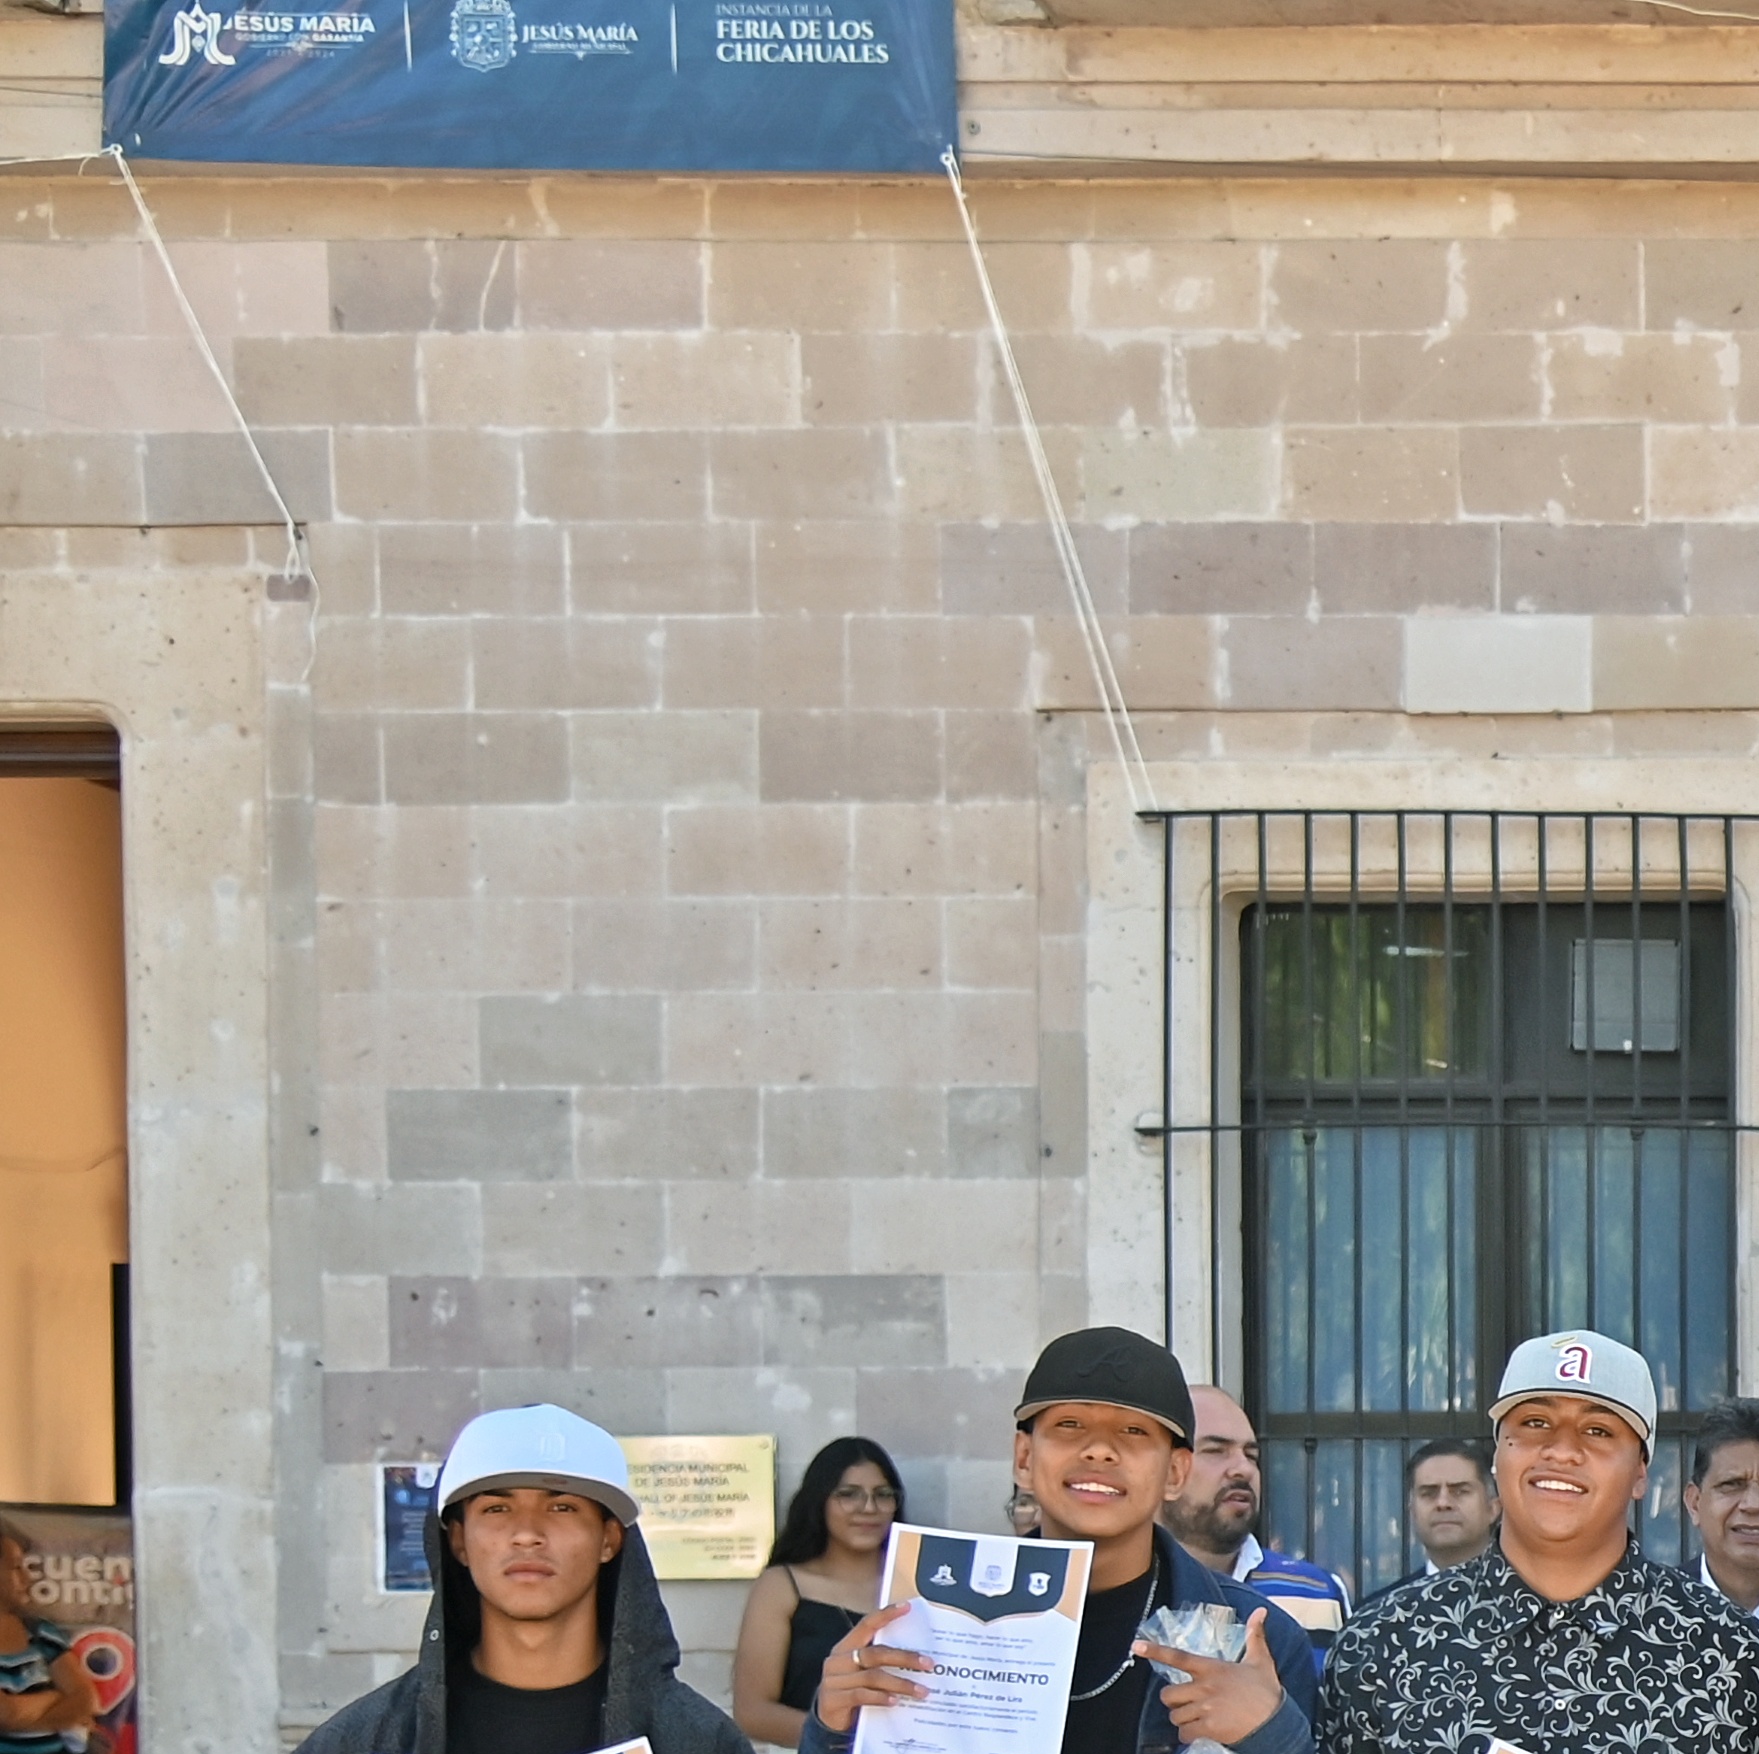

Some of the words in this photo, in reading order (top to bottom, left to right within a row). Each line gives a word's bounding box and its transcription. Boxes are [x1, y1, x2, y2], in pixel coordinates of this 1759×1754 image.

[224, 13, 294, 32] JESÚS
[299, 13, 376, 33] MARÍA
[521, 21, 575, 42] JESÚS
[576, 21, 638, 42] MARÍA
[716, 19, 786, 40] FERIA
[791, 20, 824, 40] DE
[828, 20, 874, 41] LOS
[716, 43, 889, 63] CHICAHUALES
